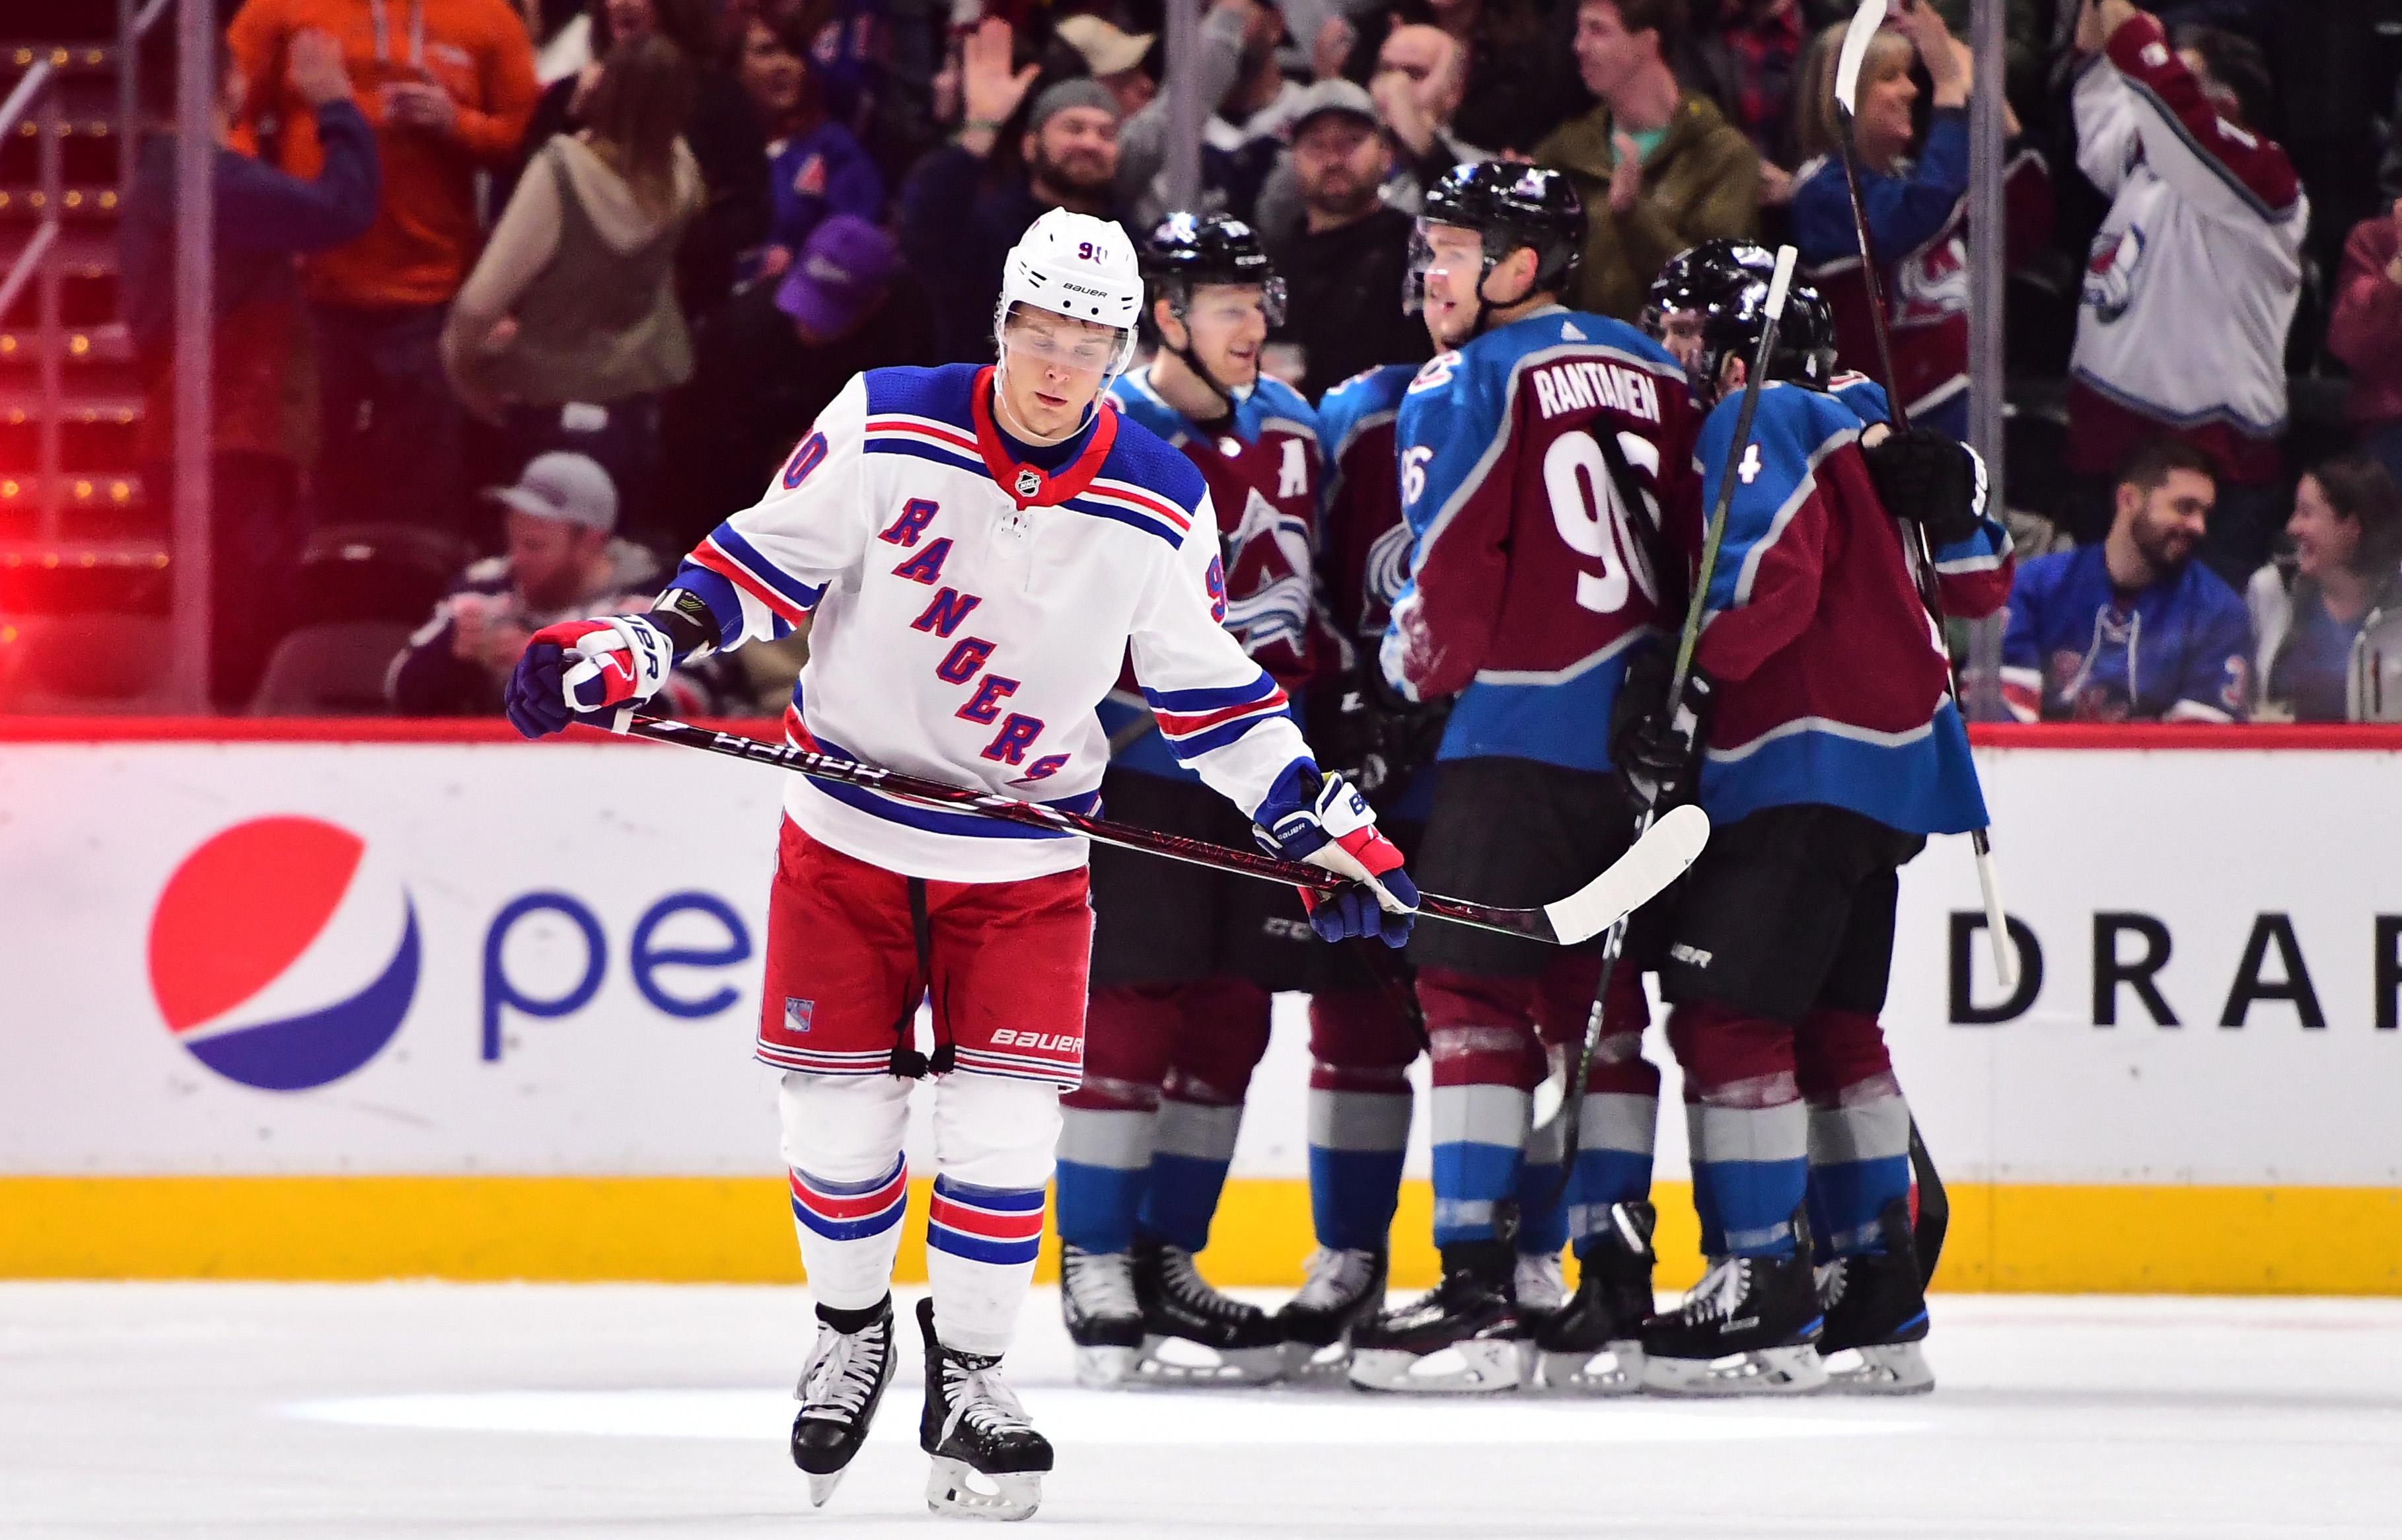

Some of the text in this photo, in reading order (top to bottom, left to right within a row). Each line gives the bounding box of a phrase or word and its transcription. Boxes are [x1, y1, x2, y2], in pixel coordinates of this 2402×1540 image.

[782, 423, 828, 490] 0
[1276, 437, 1309, 499] A
[1204, 553, 1229, 624] 9
[877, 497, 1072, 785] RANGERS
[482, 891, 752, 1061] pe
